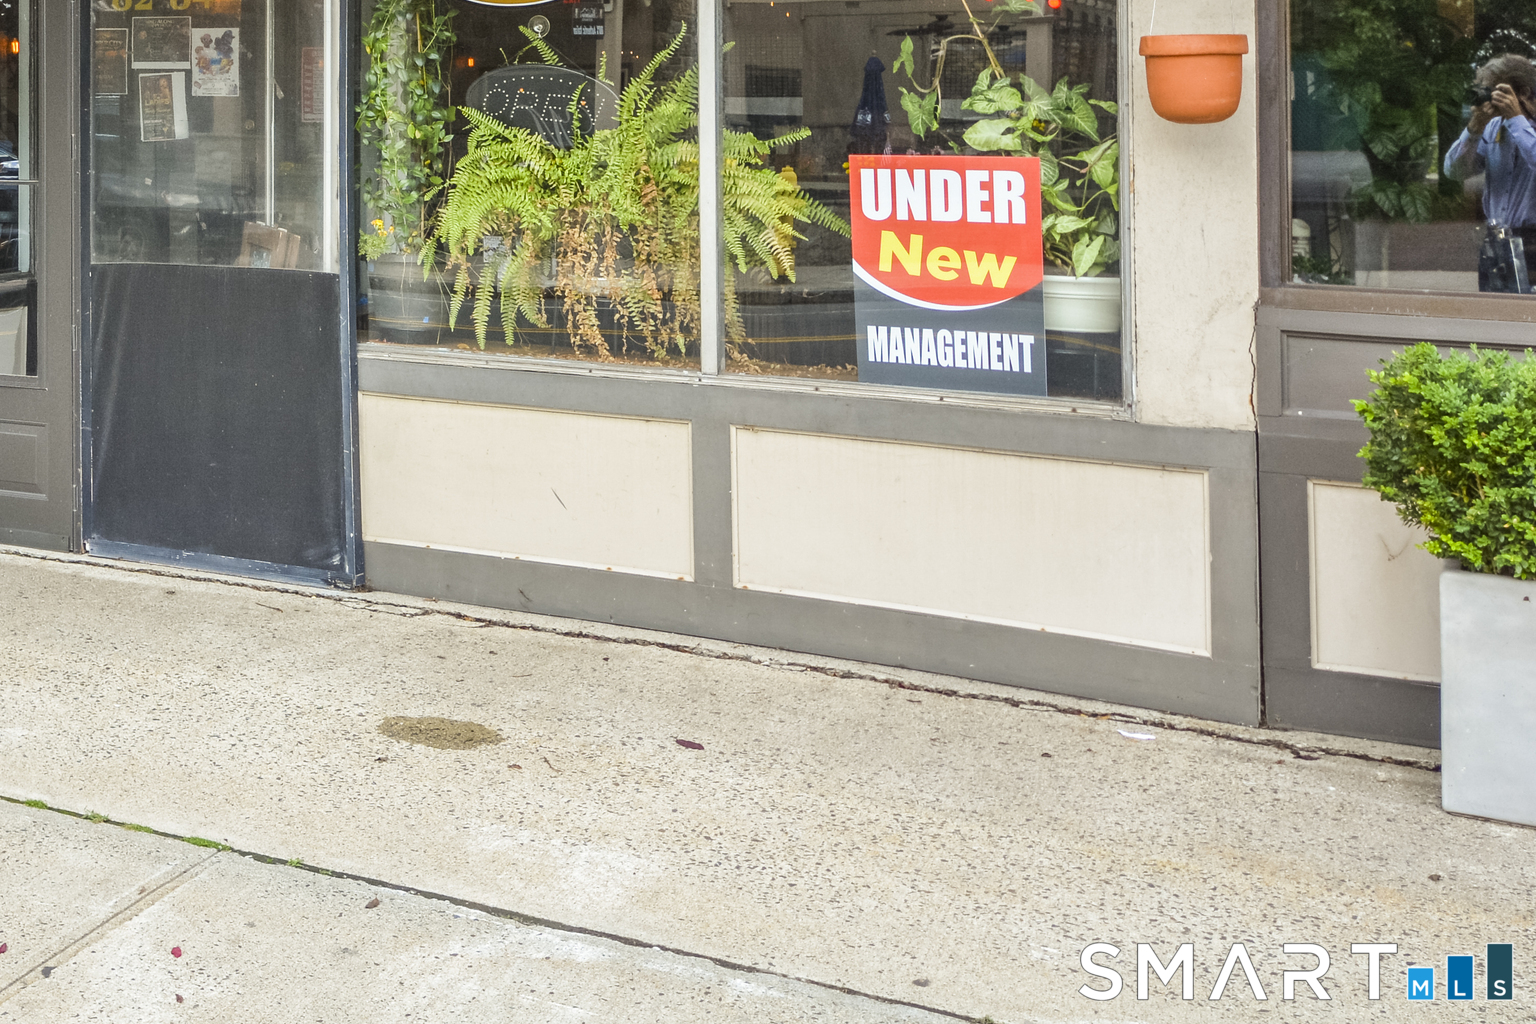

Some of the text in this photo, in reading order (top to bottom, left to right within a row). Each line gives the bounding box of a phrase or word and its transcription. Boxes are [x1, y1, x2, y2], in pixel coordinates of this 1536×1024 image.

[483, 88, 606, 126] OPEN
[860, 168, 1027, 225] UNDER
[878, 230, 1018, 289] New
[867, 325, 1035, 374] MANAGEMENT
